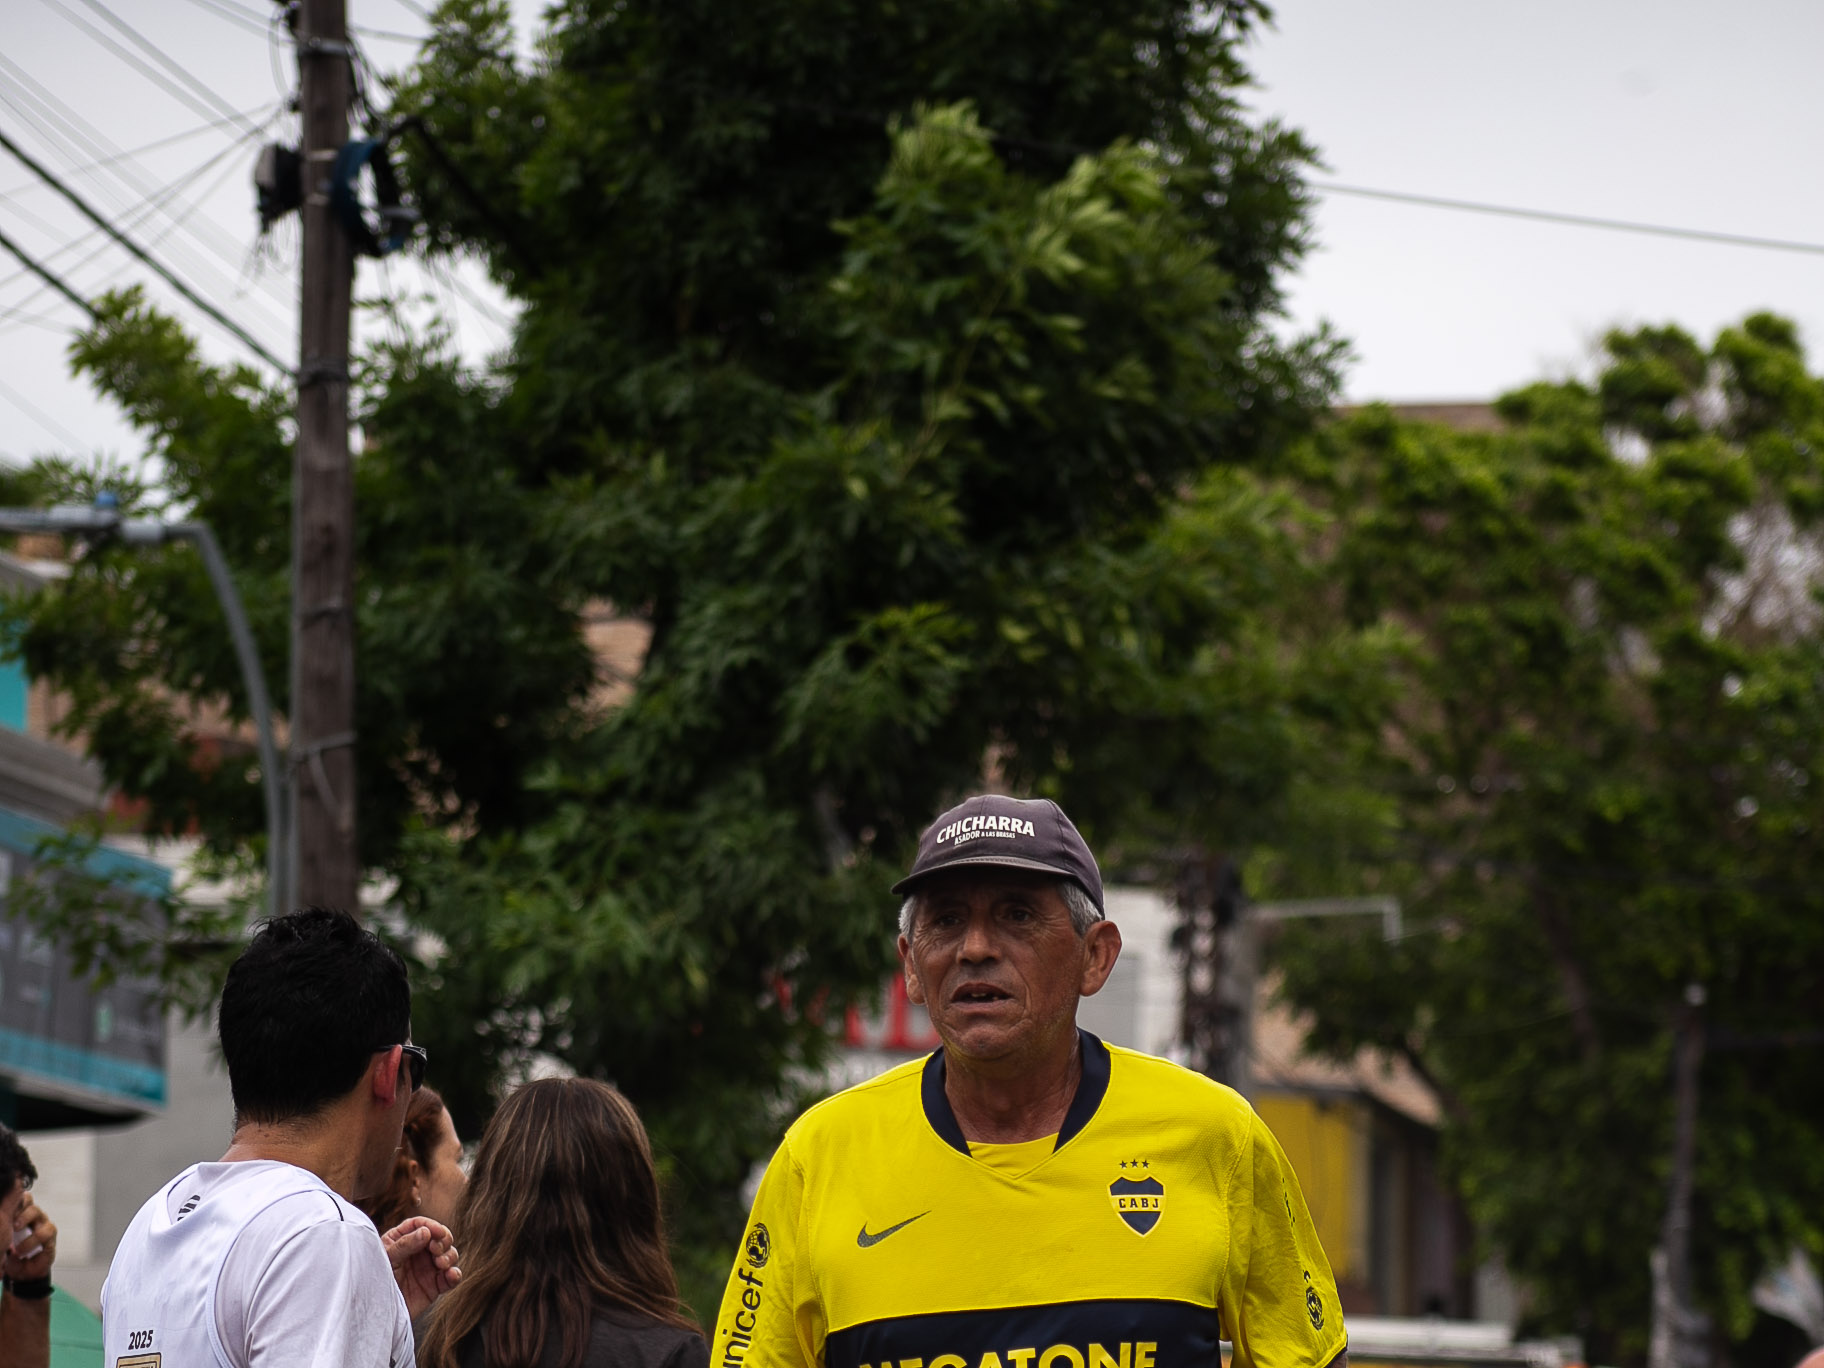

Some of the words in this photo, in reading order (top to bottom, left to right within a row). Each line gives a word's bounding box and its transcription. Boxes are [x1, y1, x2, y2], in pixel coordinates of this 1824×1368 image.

[936, 815, 1035, 844] CHICHARRA
[954, 830, 980, 845] ASADOR
[1118, 1197, 1159, 1209] CABJ
[128, 1329, 153, 1350] 2025
